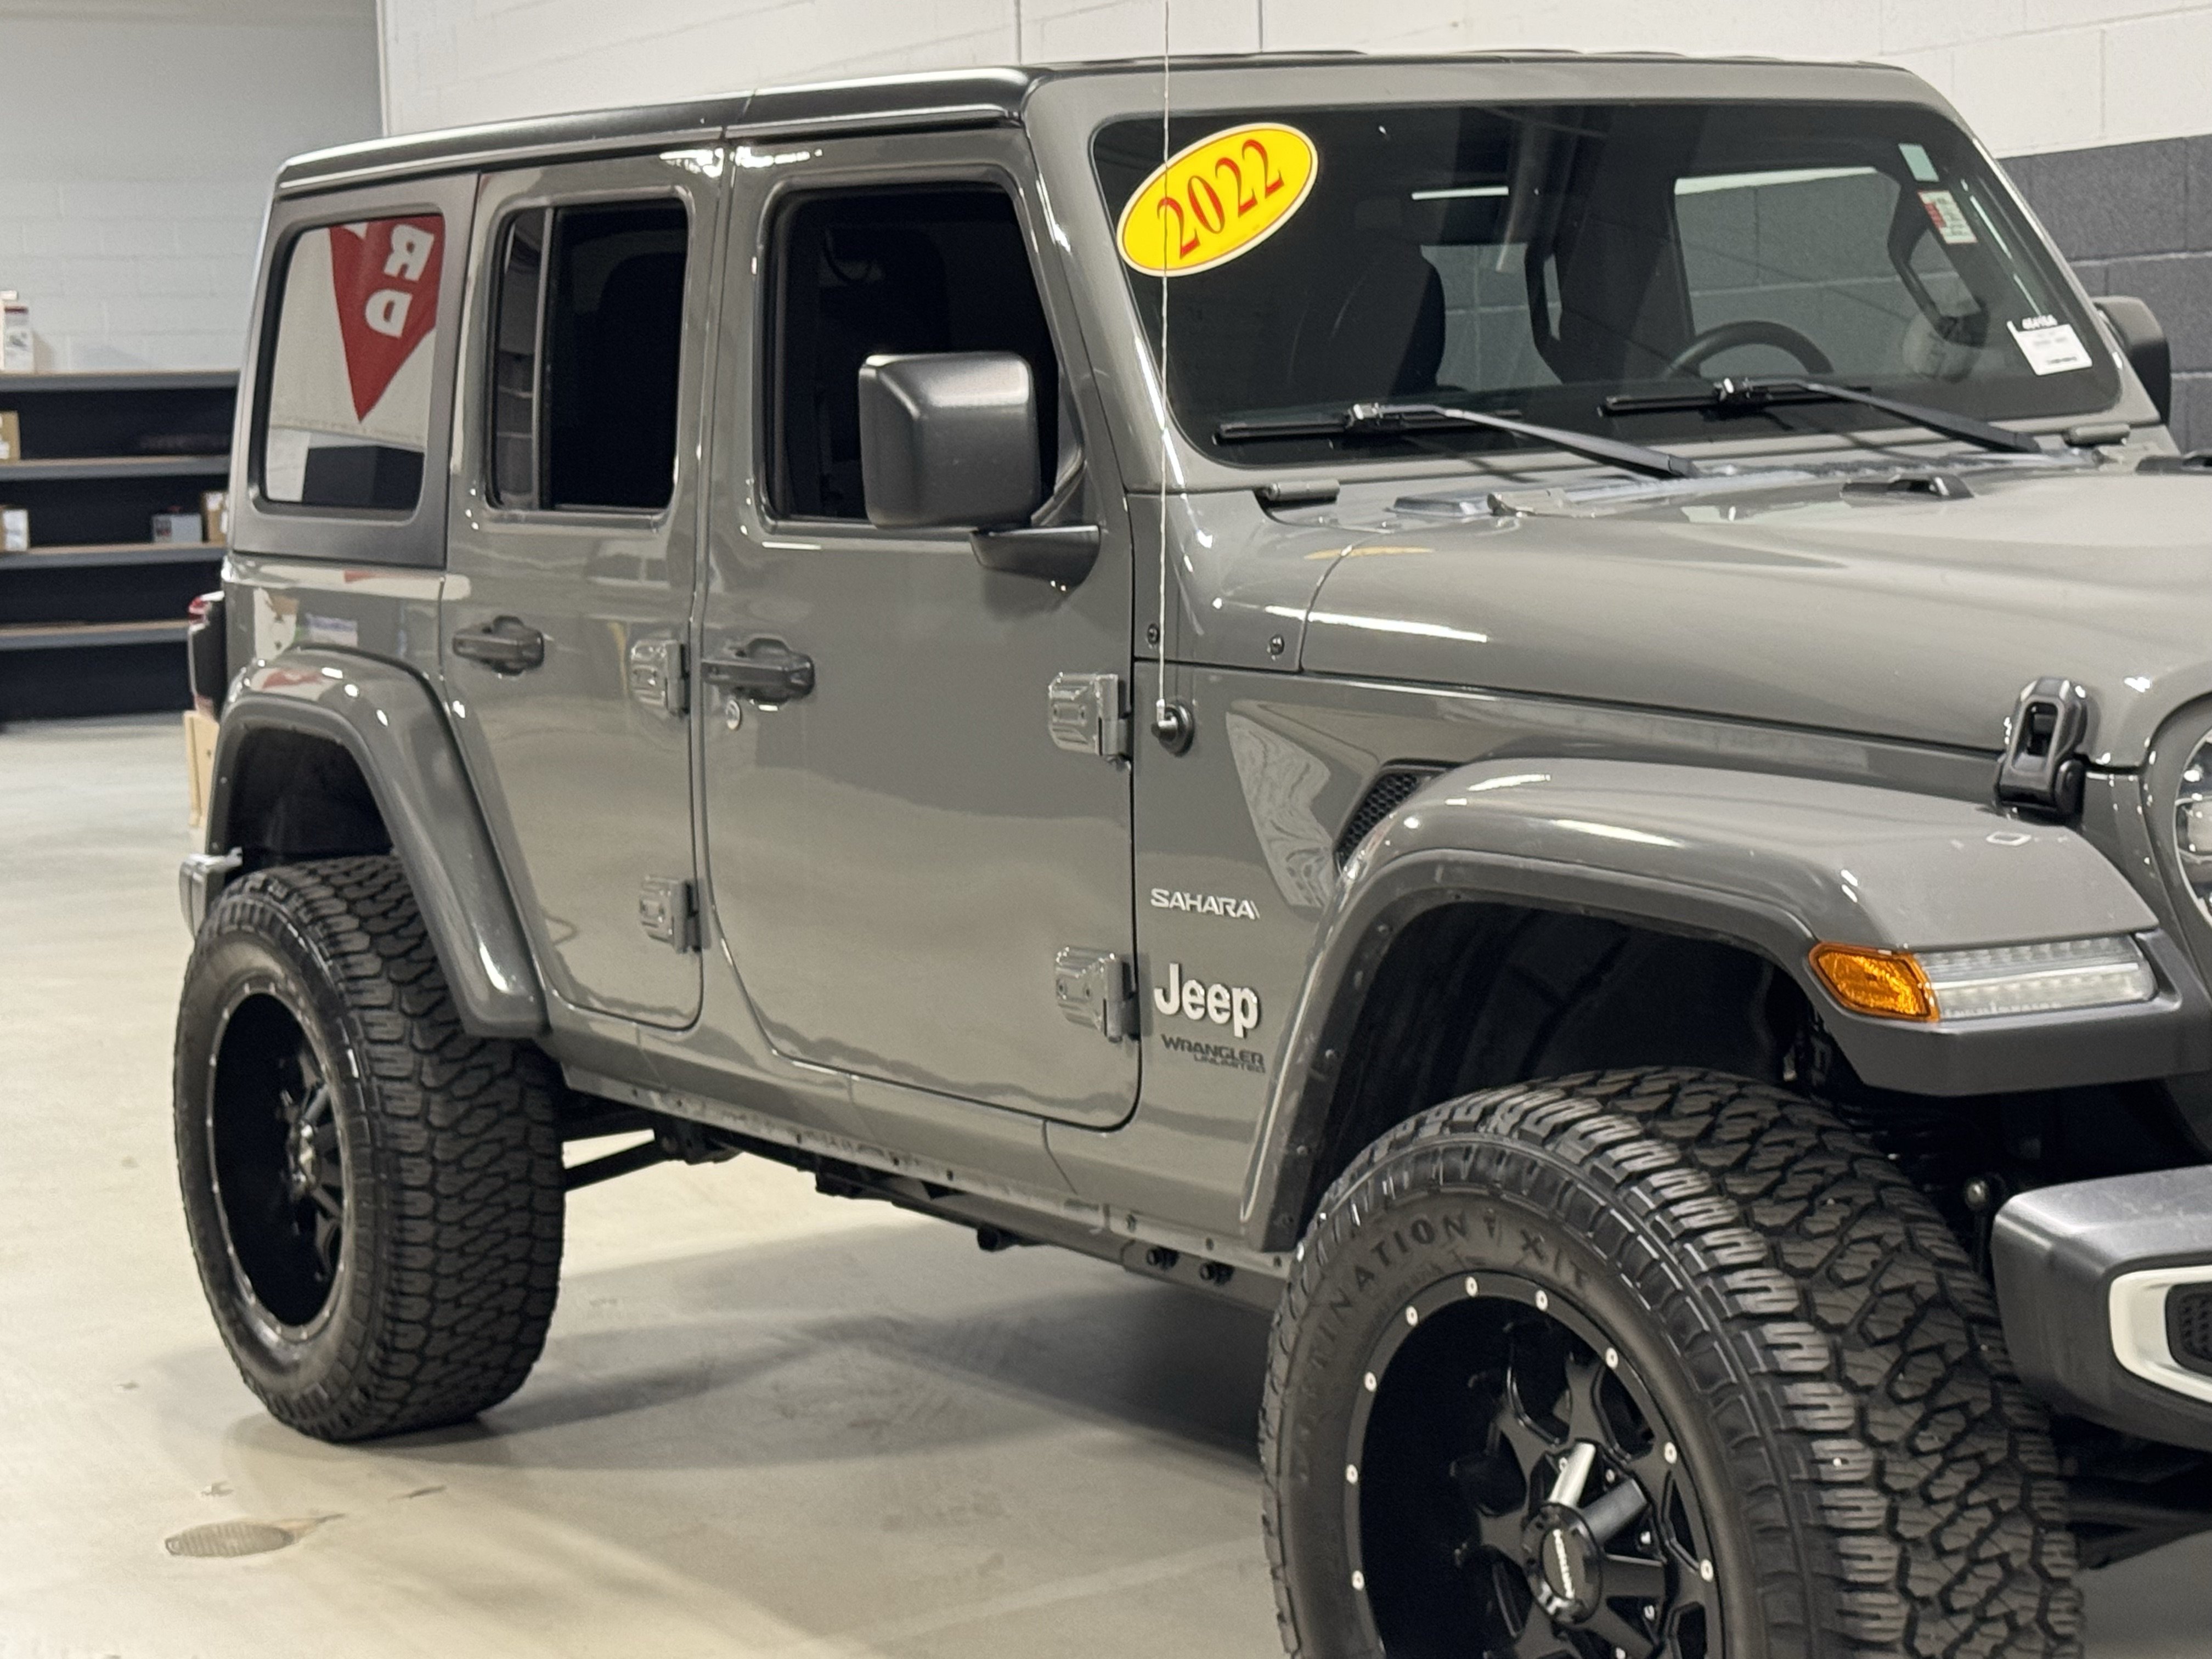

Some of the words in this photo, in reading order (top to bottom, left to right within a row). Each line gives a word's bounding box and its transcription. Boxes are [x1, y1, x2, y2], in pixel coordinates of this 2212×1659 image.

[1156, 138, 1285, 259] 2022
[1150, 887, 1261, 920] SAHARA
[1154, 962, 1262, 1039] Jeep
[1160, 1033, 1265, 1065] WRANGLER
